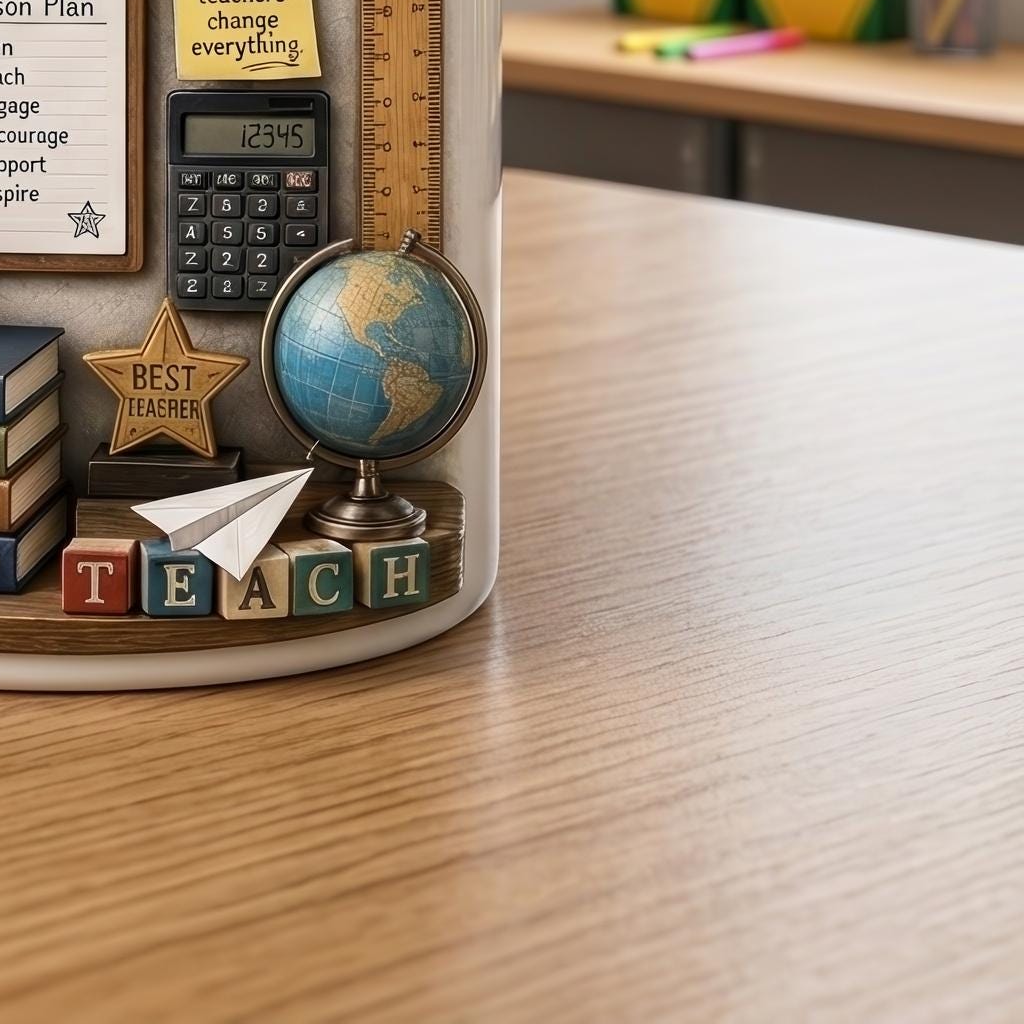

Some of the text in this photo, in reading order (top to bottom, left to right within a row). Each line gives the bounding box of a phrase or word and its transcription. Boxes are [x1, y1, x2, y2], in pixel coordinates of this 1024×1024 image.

[207, 10, 279, 35] change
[241, 124, 304, 148] 12345
[132, 363, 197, 392] BEST
